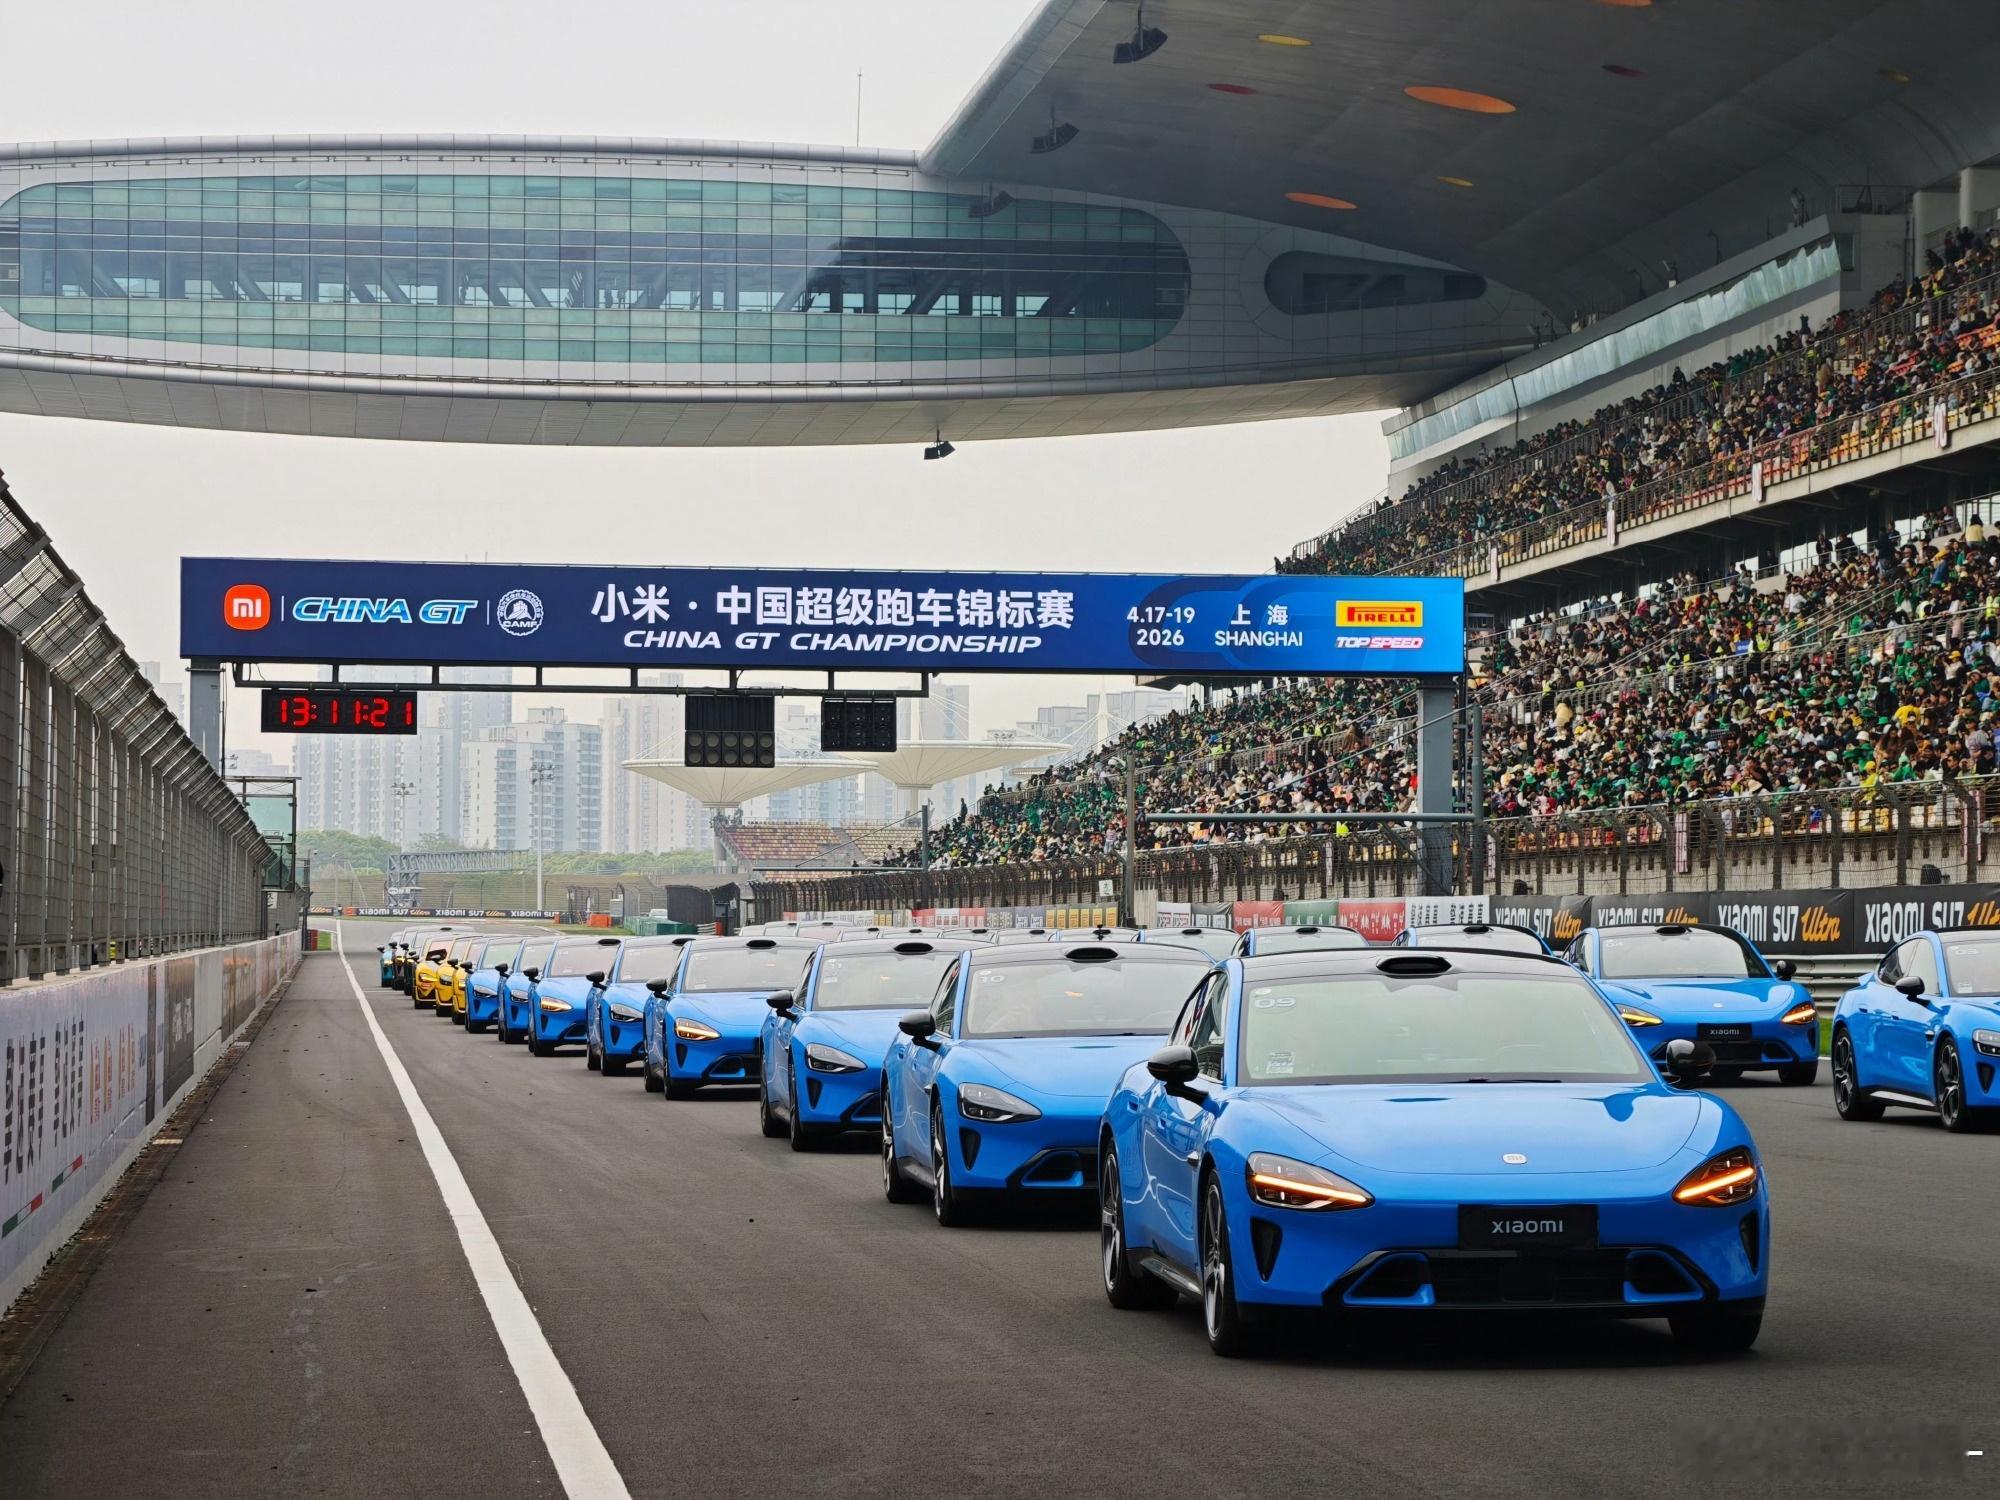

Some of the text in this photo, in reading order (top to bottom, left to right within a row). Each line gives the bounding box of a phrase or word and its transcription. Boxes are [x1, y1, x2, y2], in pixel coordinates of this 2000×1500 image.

[292, 597, 412, 623] CHINA
[418, 600, 478, 624] GT
[1126, 606, 1195, 624] 4.17-19
[1347, 606, 1416, 622] PIRELLI
[503, 620, 537, 628] CAMF
[624, 630, 1042, 653] CHINA GT CHAMPIONSHIP
[1136, 628, 1185, 646] 2026
[1214, 630, 1303, 647] SHANGHAI
[1533, 908, 1553, 938] SU7
[1554, 908, 1582, 939] Ultra
[1773, 905, 1799, 942] SU7
[1801, 905, 1841, 943] Ultra
[1932, 901, 1965, 929] SU7
